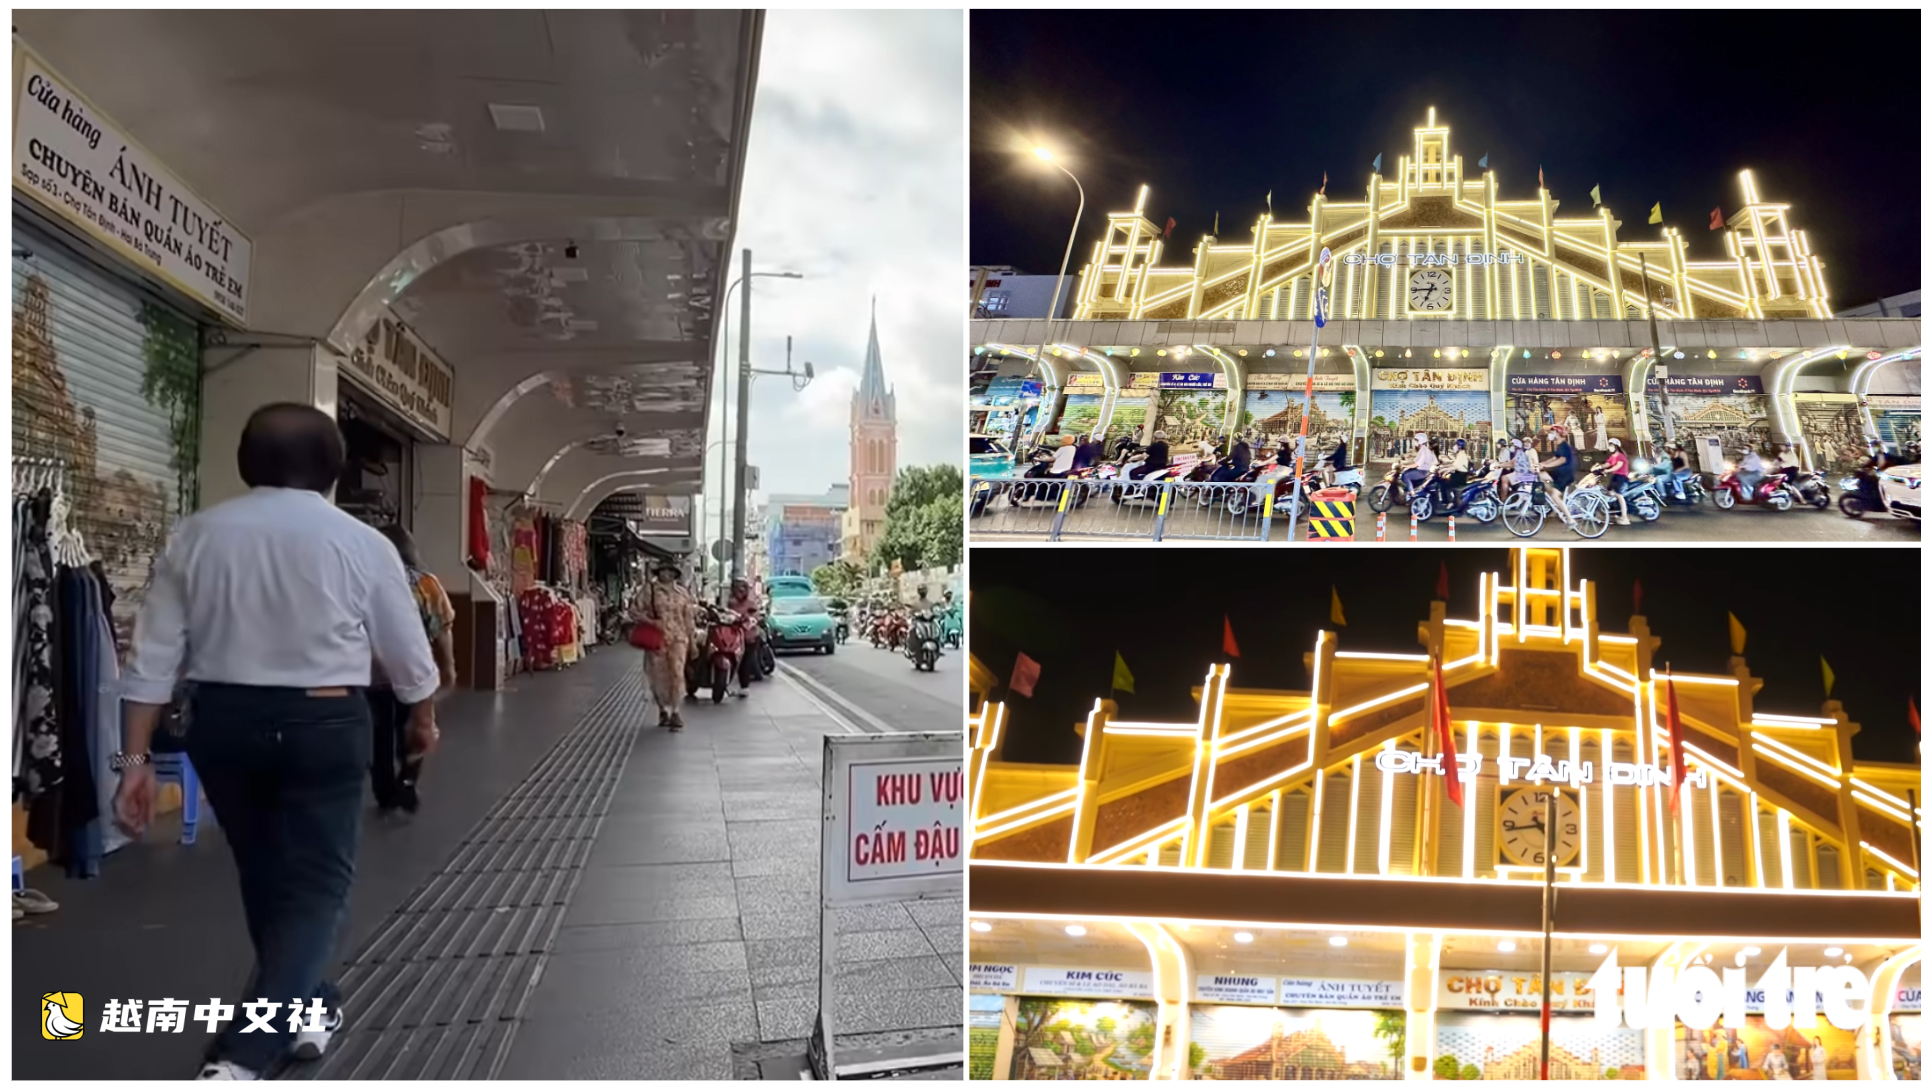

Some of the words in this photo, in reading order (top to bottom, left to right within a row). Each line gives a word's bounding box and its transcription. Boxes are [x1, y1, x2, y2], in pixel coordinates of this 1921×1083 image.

[28, 75, 61, 114] Cửa
[61, 99, 101, 150] hàng
[109, 146, 162, 212] ÁNH
[170, 195, 232, 262] TUYẾT
[29, 138, 104, 204] CHUYÊN
[108, 192, 140, 228] BÁN
[185, 244, 202, 271] ÁO
[205, 261, 226, 289] TRẺ
[227, 277, 243, 299] EM
[1343, 253, 1398, 269] CHỢ
[1407, 251, 1458, 266] TÂN
[1465, 253, 1524, 267] ĐỊNH
[1377, 370, 1409, 384] CHỢ
[1412, 369, 1443, 382] TÂN
[1447, 371, 1484, 384] ĐỊNH
[1511, 376, 1526, 385] CỬA
[1528, 376, 1549, 385] HÀNG
[1550, 376, 1566, 385] TÂN
[1567, 378, 1586, 387] ĐỊNH
[1687, 377, 1703, 386] TÂN
[1704, 378, 1724, 387] ĐỊNH
[646, 508, 685, 518] TIERRA
[876, 773, 921, 806] KHU
[1565, 823, 1577, 835] 3
[855, 820, 906, 866] CẤM
[914, 820, 959, 867] ĐẬU
[1066, 971, 1092, 980] KIM
[1095, 970, 1123, 982] CÚC
[1215, 976, 1258, 986] NHUNG
[1318, 980, 1346, 992] ÁNH
[1349, 981, 1392, 993] TUYẾT
[1446, 975, 1503, 1000] CHỢ
[1504, 999, 1538, 1008] Chào
